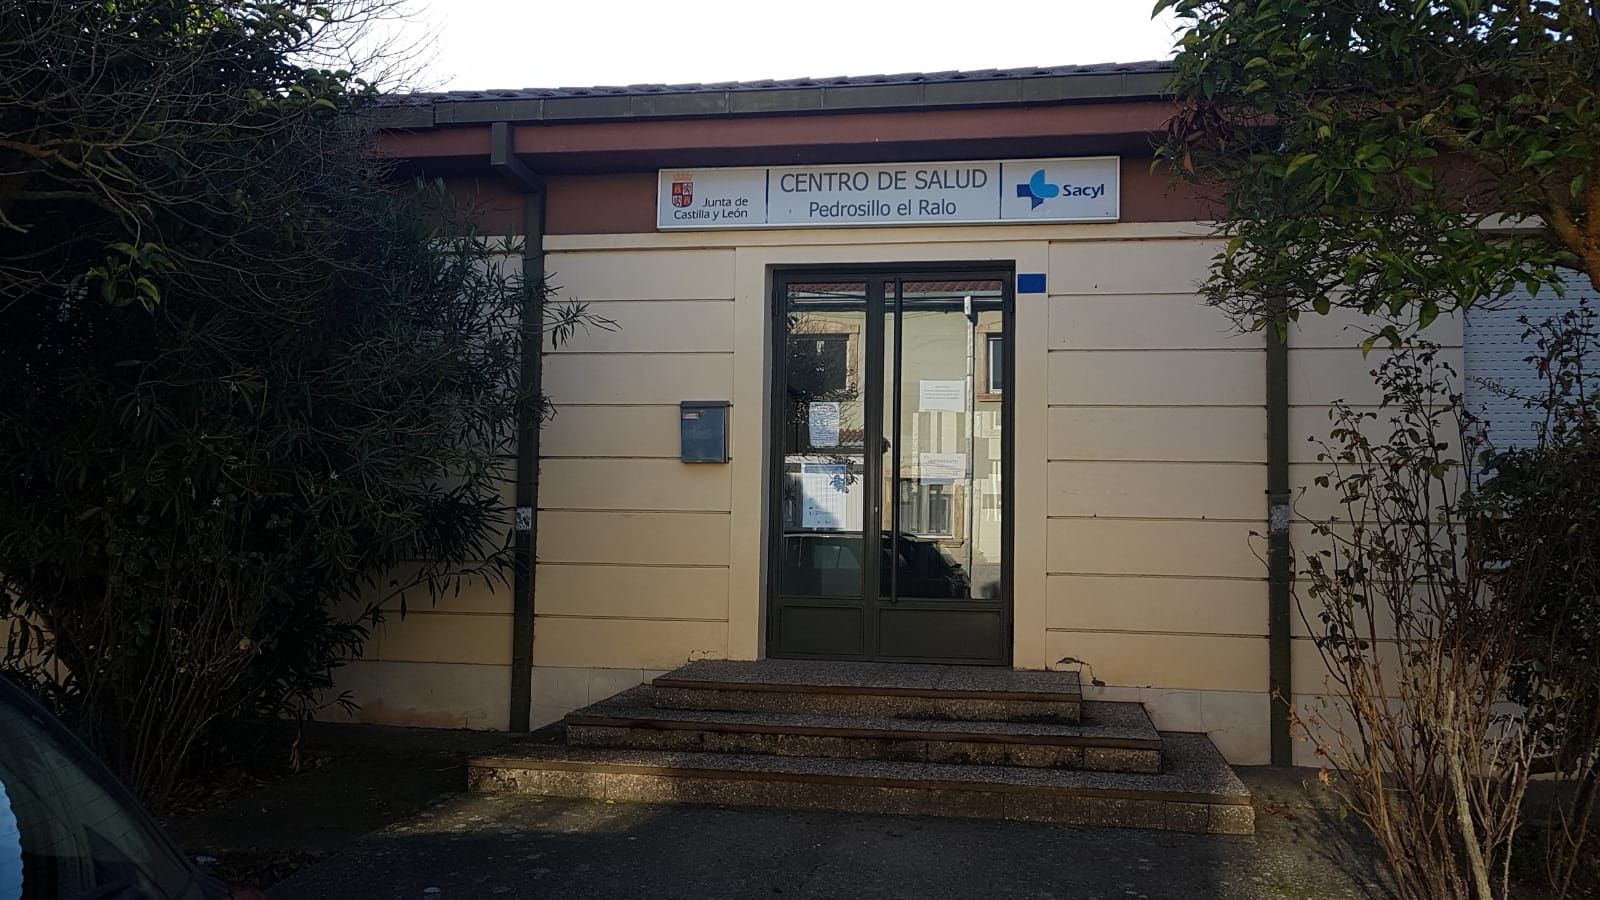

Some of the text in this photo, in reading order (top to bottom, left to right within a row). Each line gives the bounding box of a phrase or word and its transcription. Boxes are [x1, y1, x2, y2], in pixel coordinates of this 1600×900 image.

[780, 168, 988, 193] CENTRO DE SALUD
[1062, 183, 1105, 199] Sacyl
[702, 196, 749, 208] Junta de
[809, 198, 957, 218] Pedrosillo el Ralo
[673, 207, 748, 221] Castilla y León
